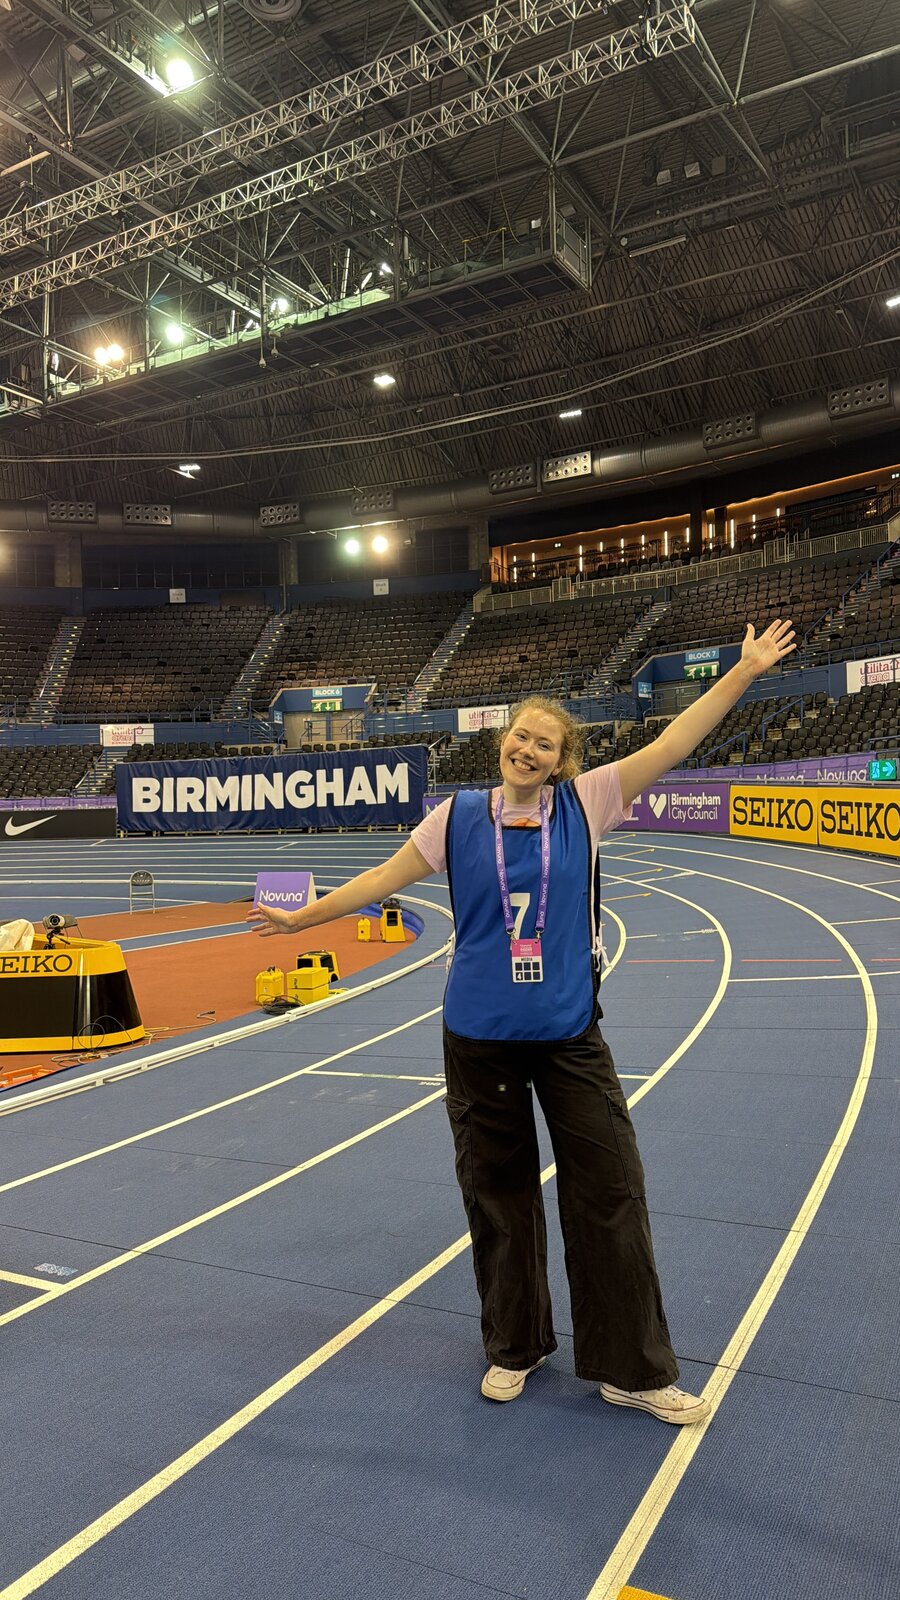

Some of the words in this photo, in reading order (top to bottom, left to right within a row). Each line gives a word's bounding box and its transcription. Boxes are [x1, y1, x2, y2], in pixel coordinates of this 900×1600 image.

[688, 651, 711, 660] BLOCK
[859, 661, 889, 676] utilita
[132, 762, 410, 813] BIRMINGHAM
[671, 792, 721, 809] Birmingham
[671, 806, 687, 823] City
[687, 806, 718, 820] Council
[733, 796, 814, 832] SEIKO
[821, 799, 900, 842] SEIKO
[259, 889, 304, 902] Novuna
[509, 892, 531, 940] 7
[0, 954, 73, 974] EIKO
